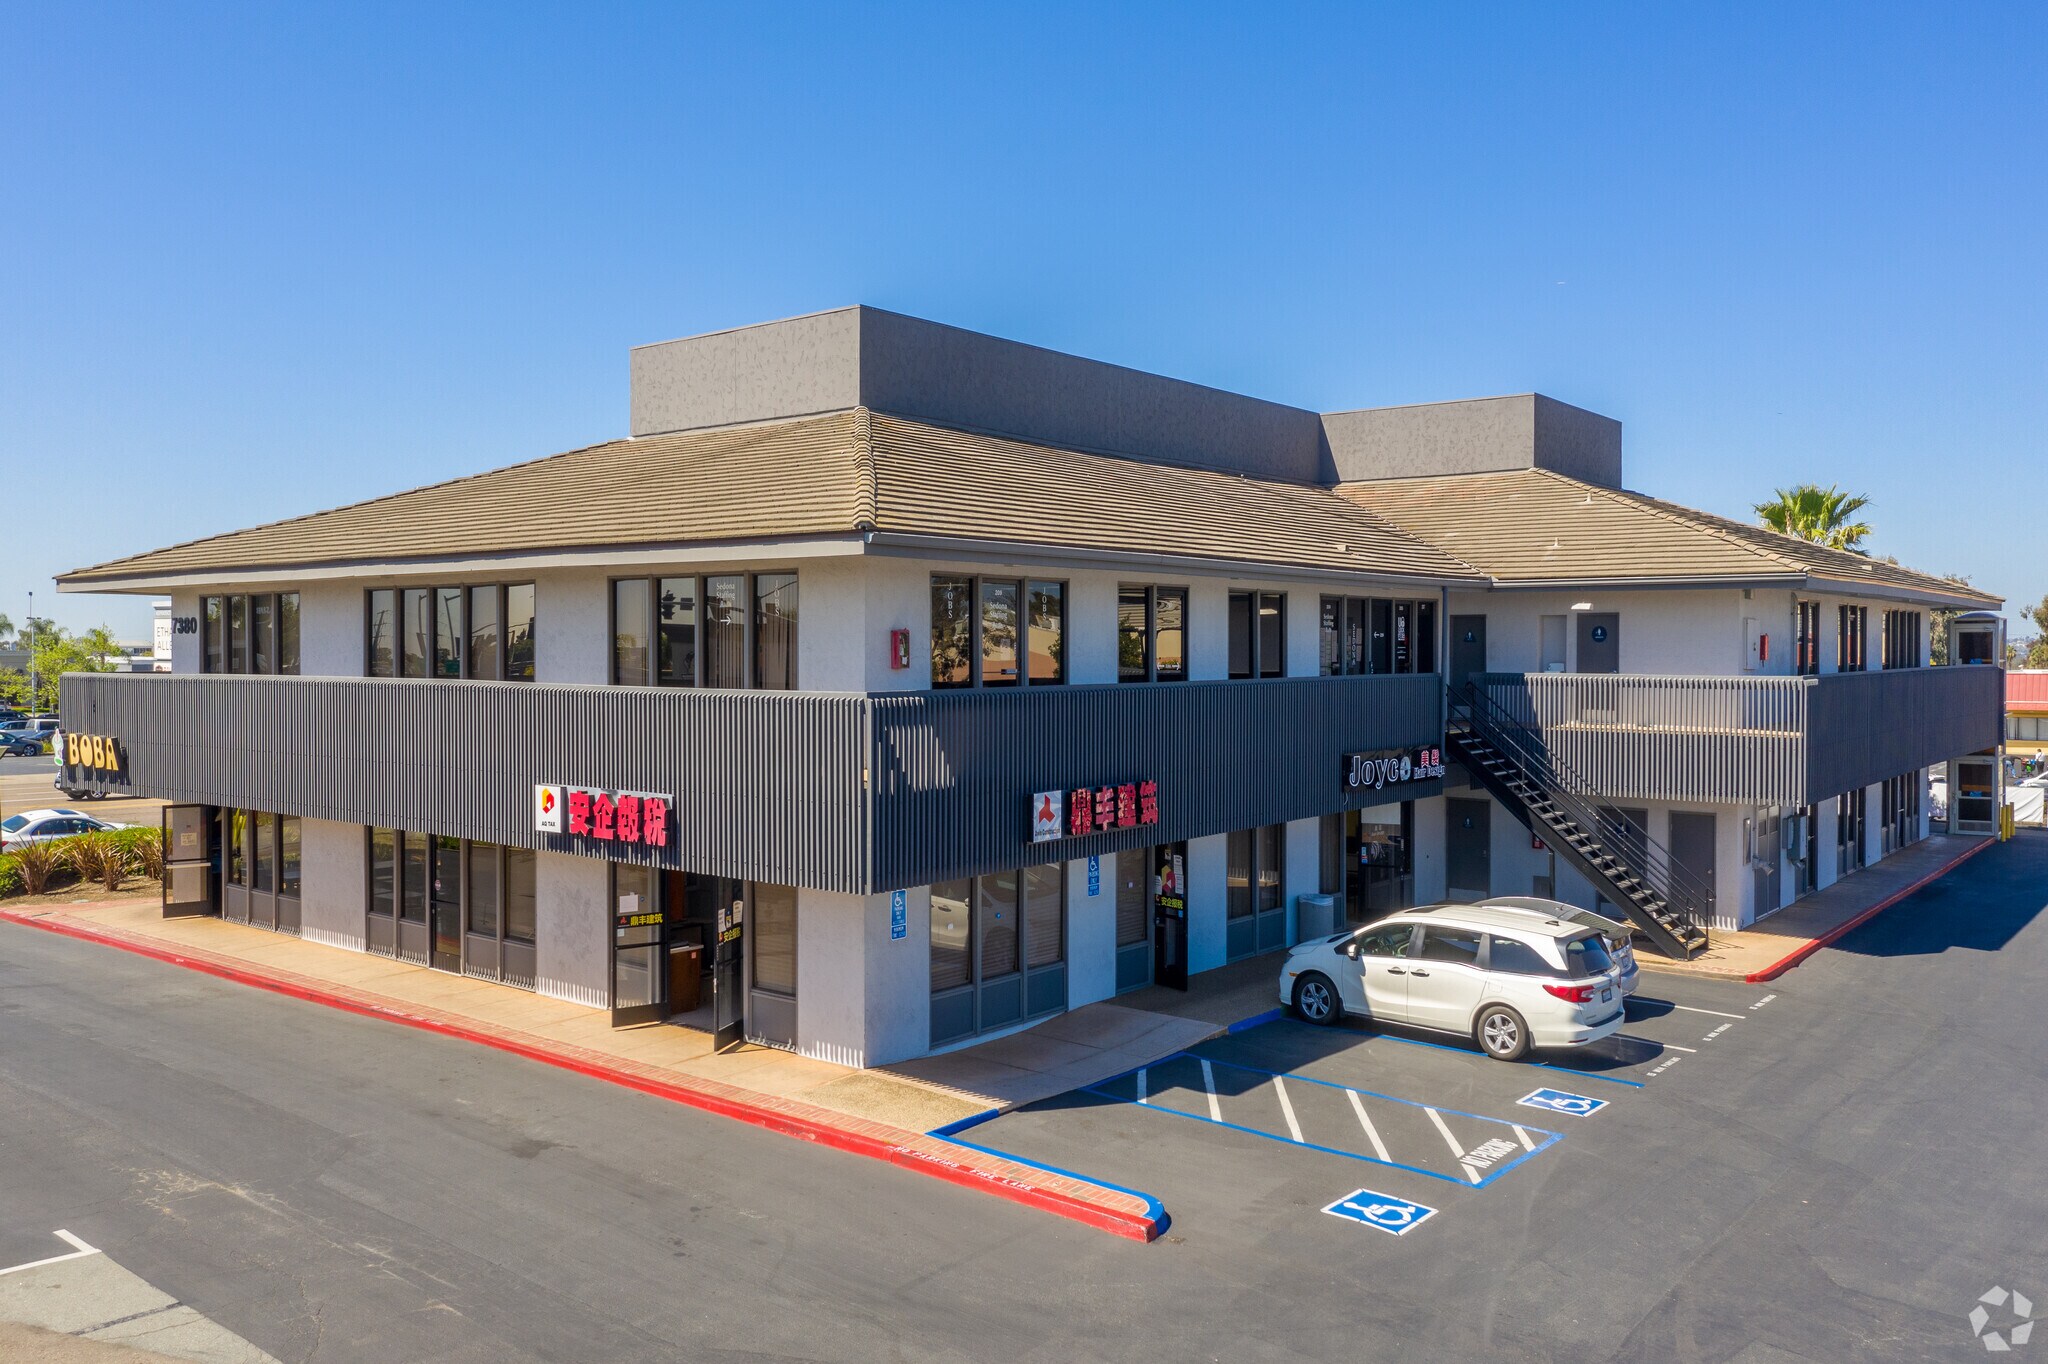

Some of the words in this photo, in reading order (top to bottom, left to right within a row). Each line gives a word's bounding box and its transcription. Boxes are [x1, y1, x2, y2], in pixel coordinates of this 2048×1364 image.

[716, 582, 735, 590] Sedona
[716, 592, 736, 600] Staffing
[989, 602, 1008, 610] Sedona
[172, 617, 197, 634] 7380
[69, 733, 119, 771] BOBA
[1413, 766, 1426, 779] Hair
[1760, 994, 1777, 1003] PARKING
[1714, 1023, 1732, 1032] PARKING
[1660, 1056, 1681, 1067] PARKING
[1469, 1138, 1518, 1162] PARKING
[1459, 1155, 1493, 1169] NO
[913, 1152, 960, 1168] PARKING
[970, 1168, 998, 1180] FIRE
[1001, 1179, 1035, 1191] LANE
